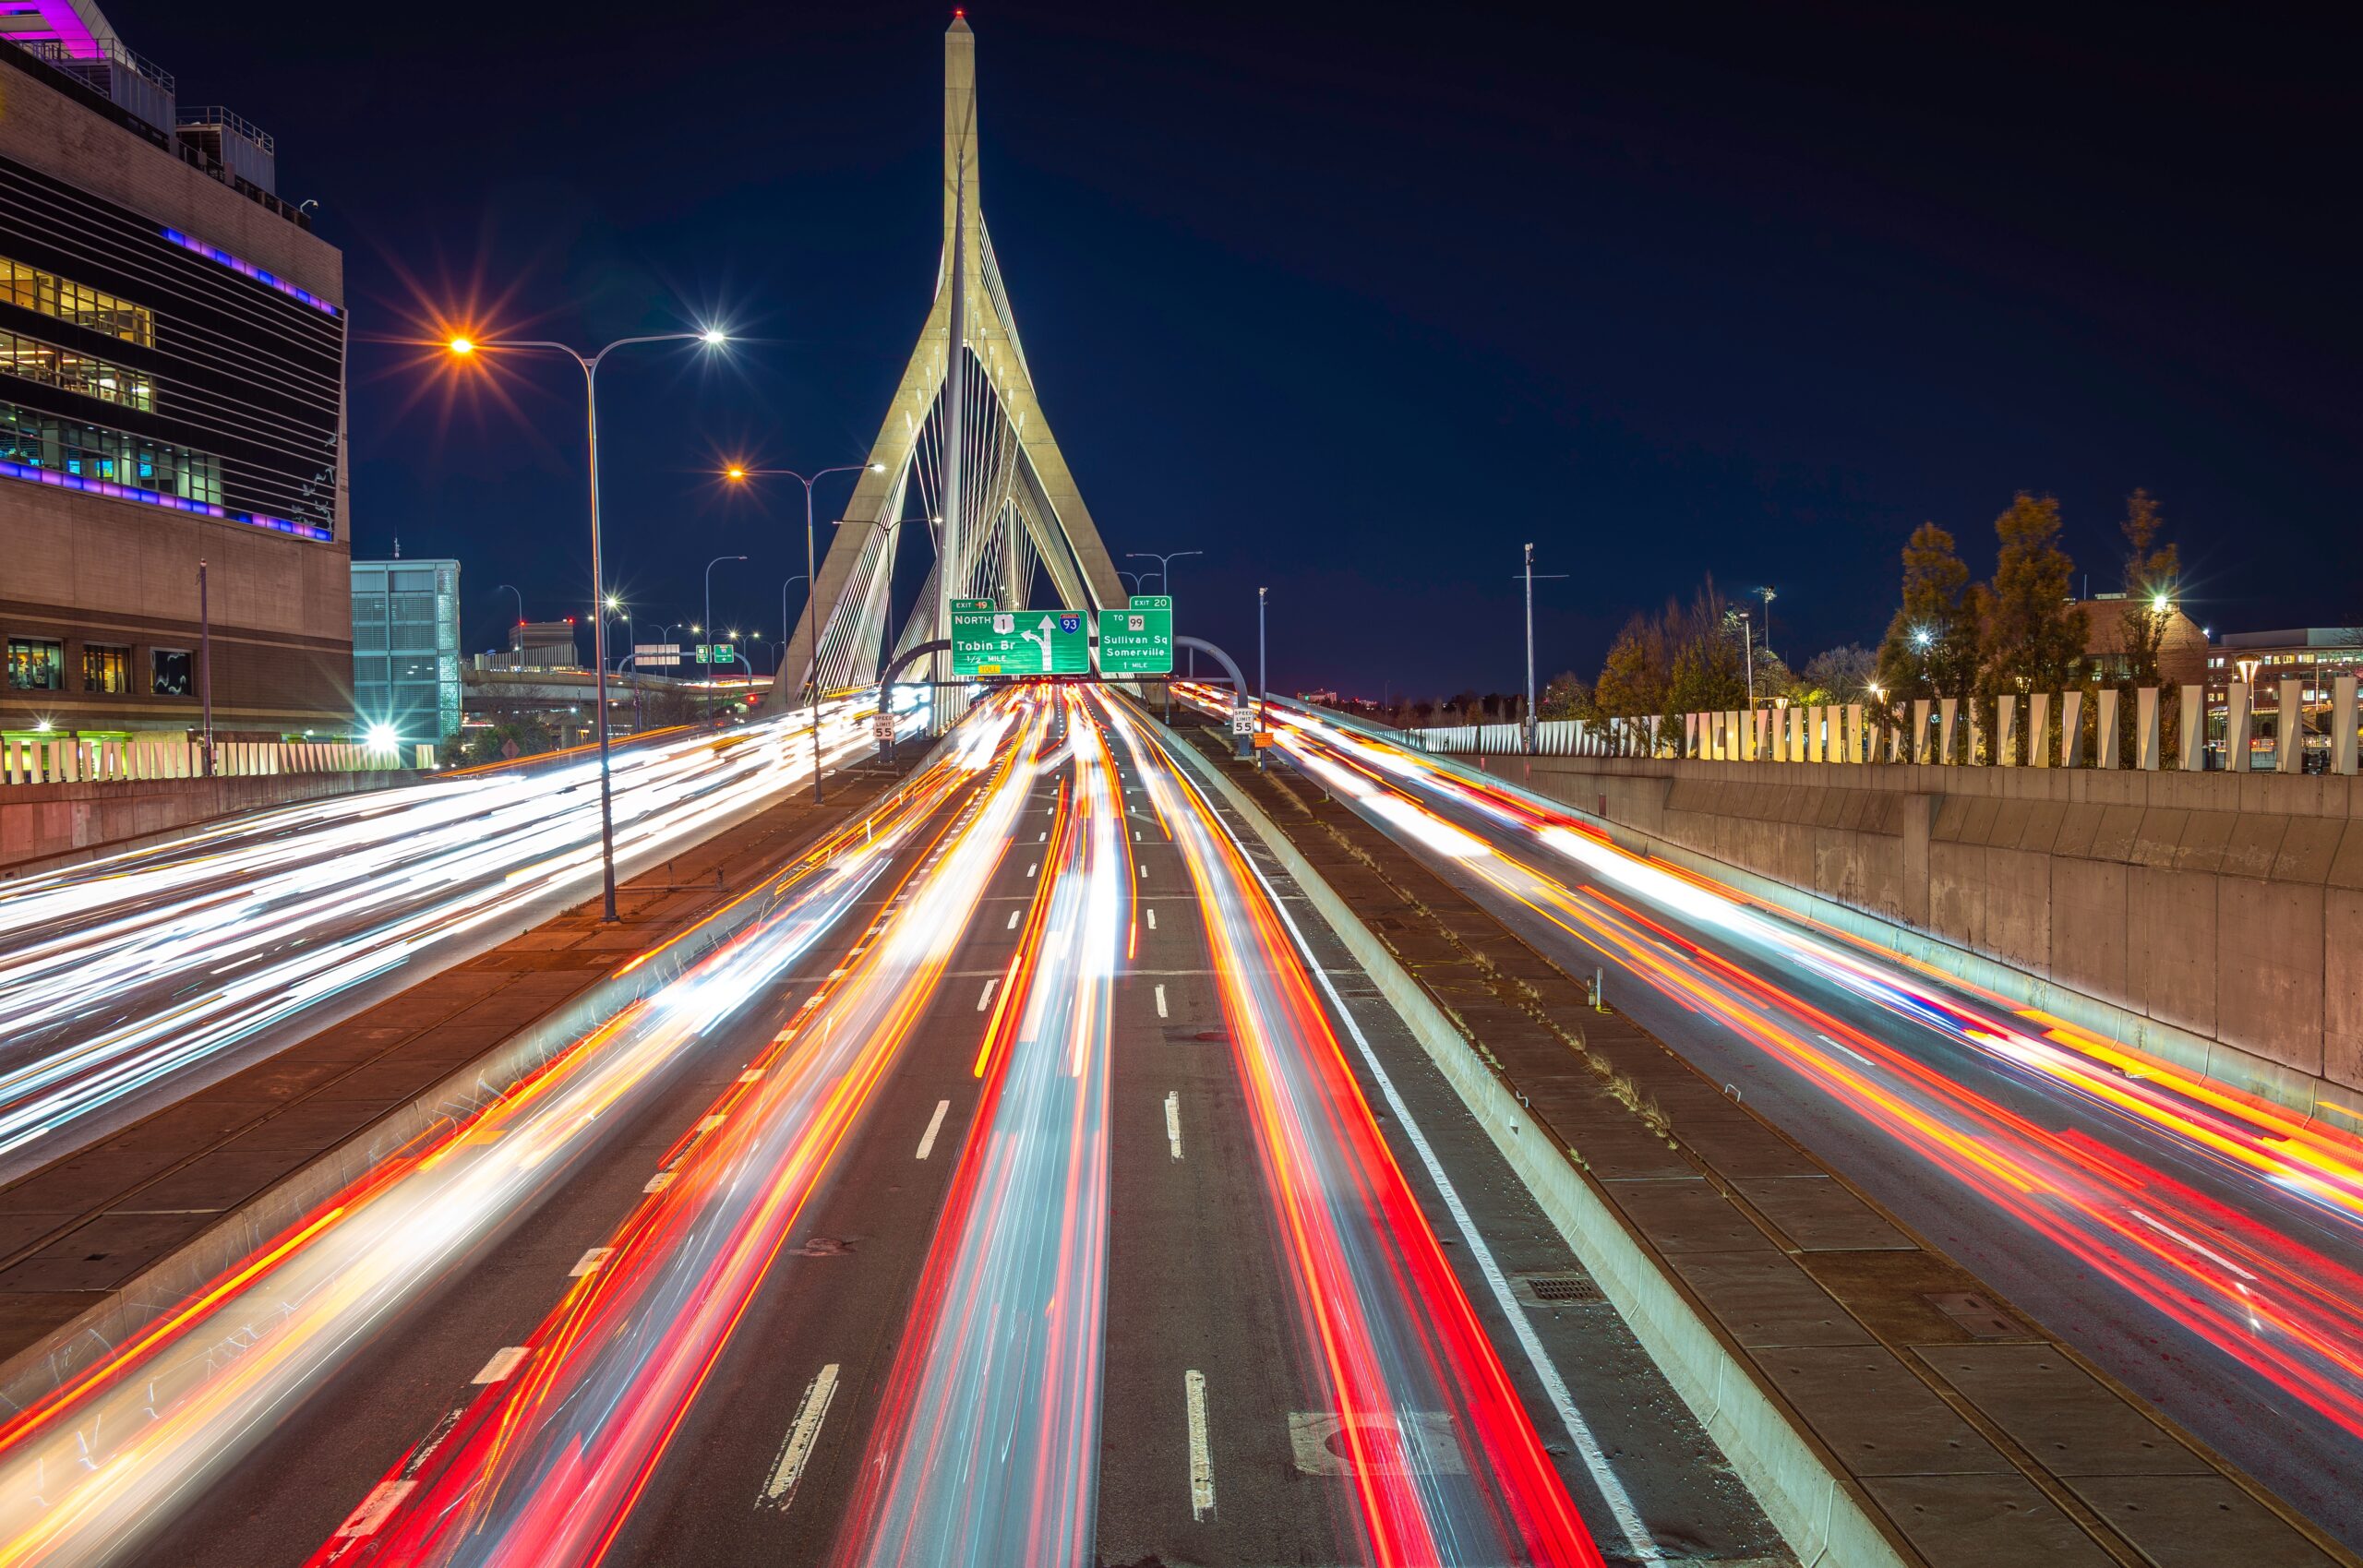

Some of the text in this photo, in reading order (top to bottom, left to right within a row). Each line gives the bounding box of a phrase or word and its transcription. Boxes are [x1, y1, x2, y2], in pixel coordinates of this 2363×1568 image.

[1154, 599, 1168, 607] 20
[954, 616, 991, 625] NORTH
[1002, 618, 1005, 630] 1
[1062, 619, 1077, 629] 93
[1130, 618, 1143, 628] 99
[1103, 635, 1168, 645] Sullivan Sq
[956, 640, 1015, 652] Tobin Br
[1106, 648, 1165, 656] Somerville
[1236, 723, 1252, 731] 55
[875, 728, 892, 736] 55
